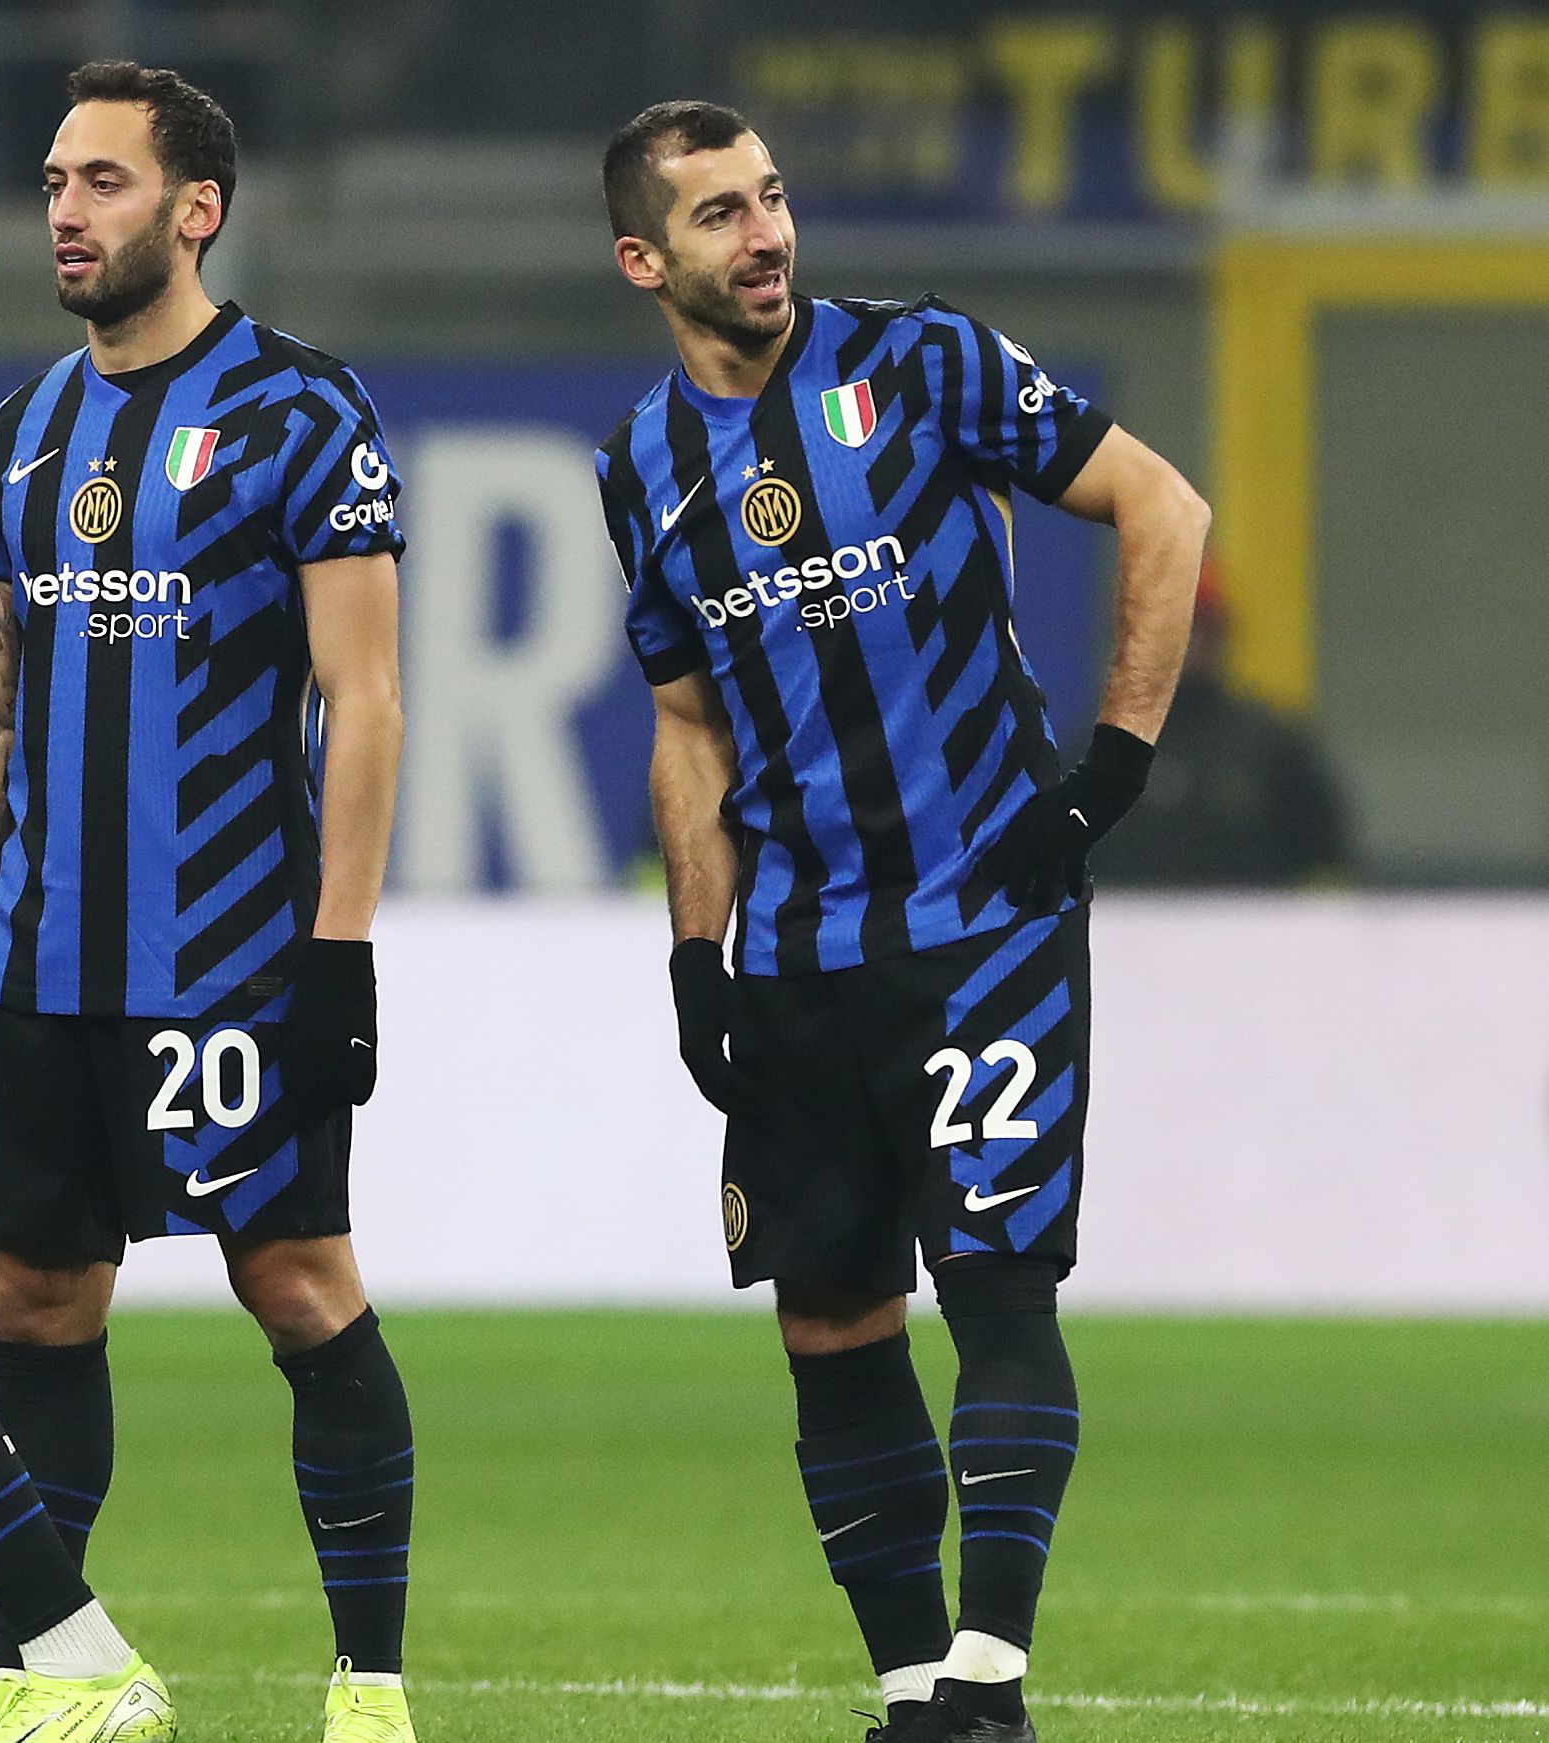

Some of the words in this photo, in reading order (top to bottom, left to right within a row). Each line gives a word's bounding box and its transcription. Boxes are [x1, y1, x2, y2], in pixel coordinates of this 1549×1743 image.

[329, 493, 395, 532] Gate.i
[690, 535, 906, 629] betsson
[796, 571, 915, 632] .sport
[78, 609, 191, 645] .sport
[147, 1028, 261, 1130] 20
[923, 1039, 1039, 1149] 22
